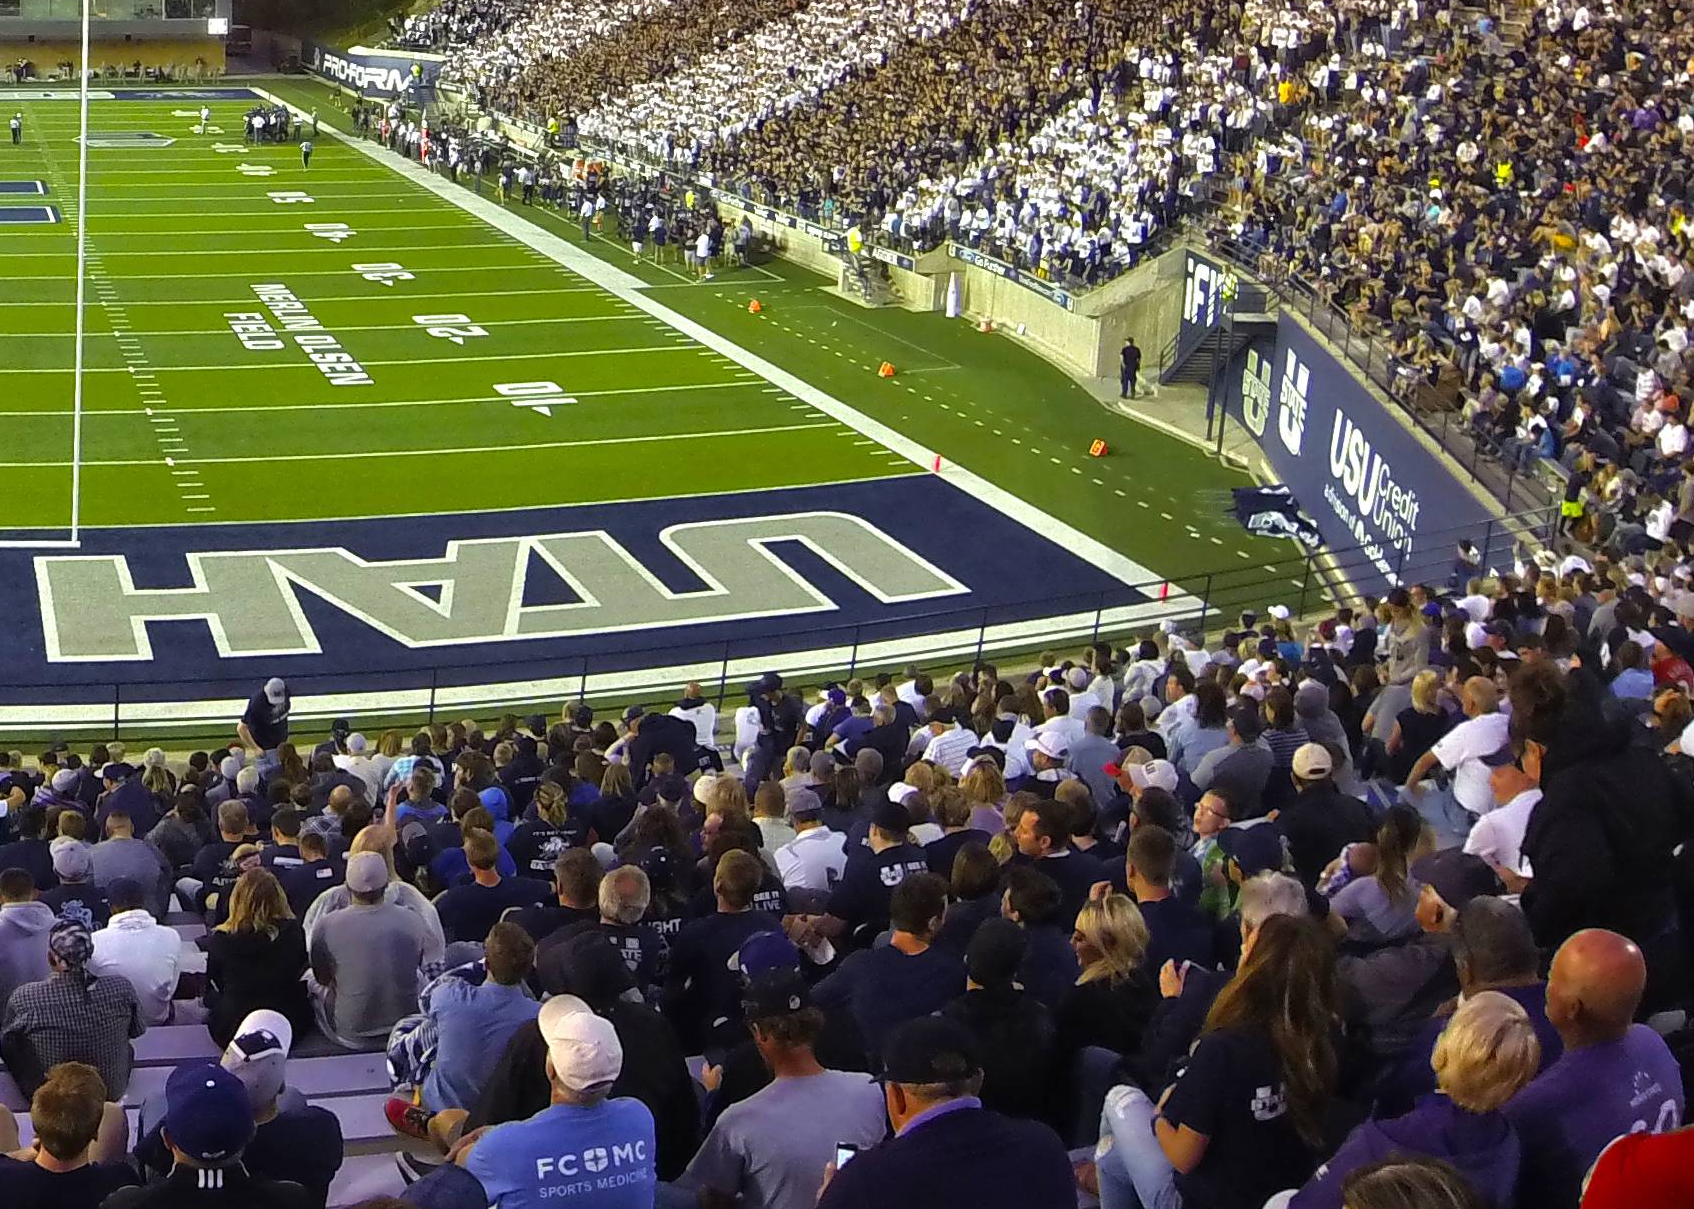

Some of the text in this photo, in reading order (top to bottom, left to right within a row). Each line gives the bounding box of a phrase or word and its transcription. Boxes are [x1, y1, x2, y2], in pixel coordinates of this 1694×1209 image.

[223, 312, 285, 350] FIELD
[249, 283, 375, 386] MERLIN OLSEN
[412, 313, 489, 338] 20
[492, 381, 579, 408] 10
[1242, 368, 1271, 418] STATE
[1280, 374, 1307, 432] STATE
[1330, 408, 1382, 516] USU
[1378, 463, 1420, 531] Credit
[1373, 493, 1413, 561] Union
[34, 509, 972, 661] UTAH
[755, 900, 781, 911] LIVE
[537, 1140, 647, 1180] FC MC
[539, 1167, 648, 1199] SPORTS MEDICINE
